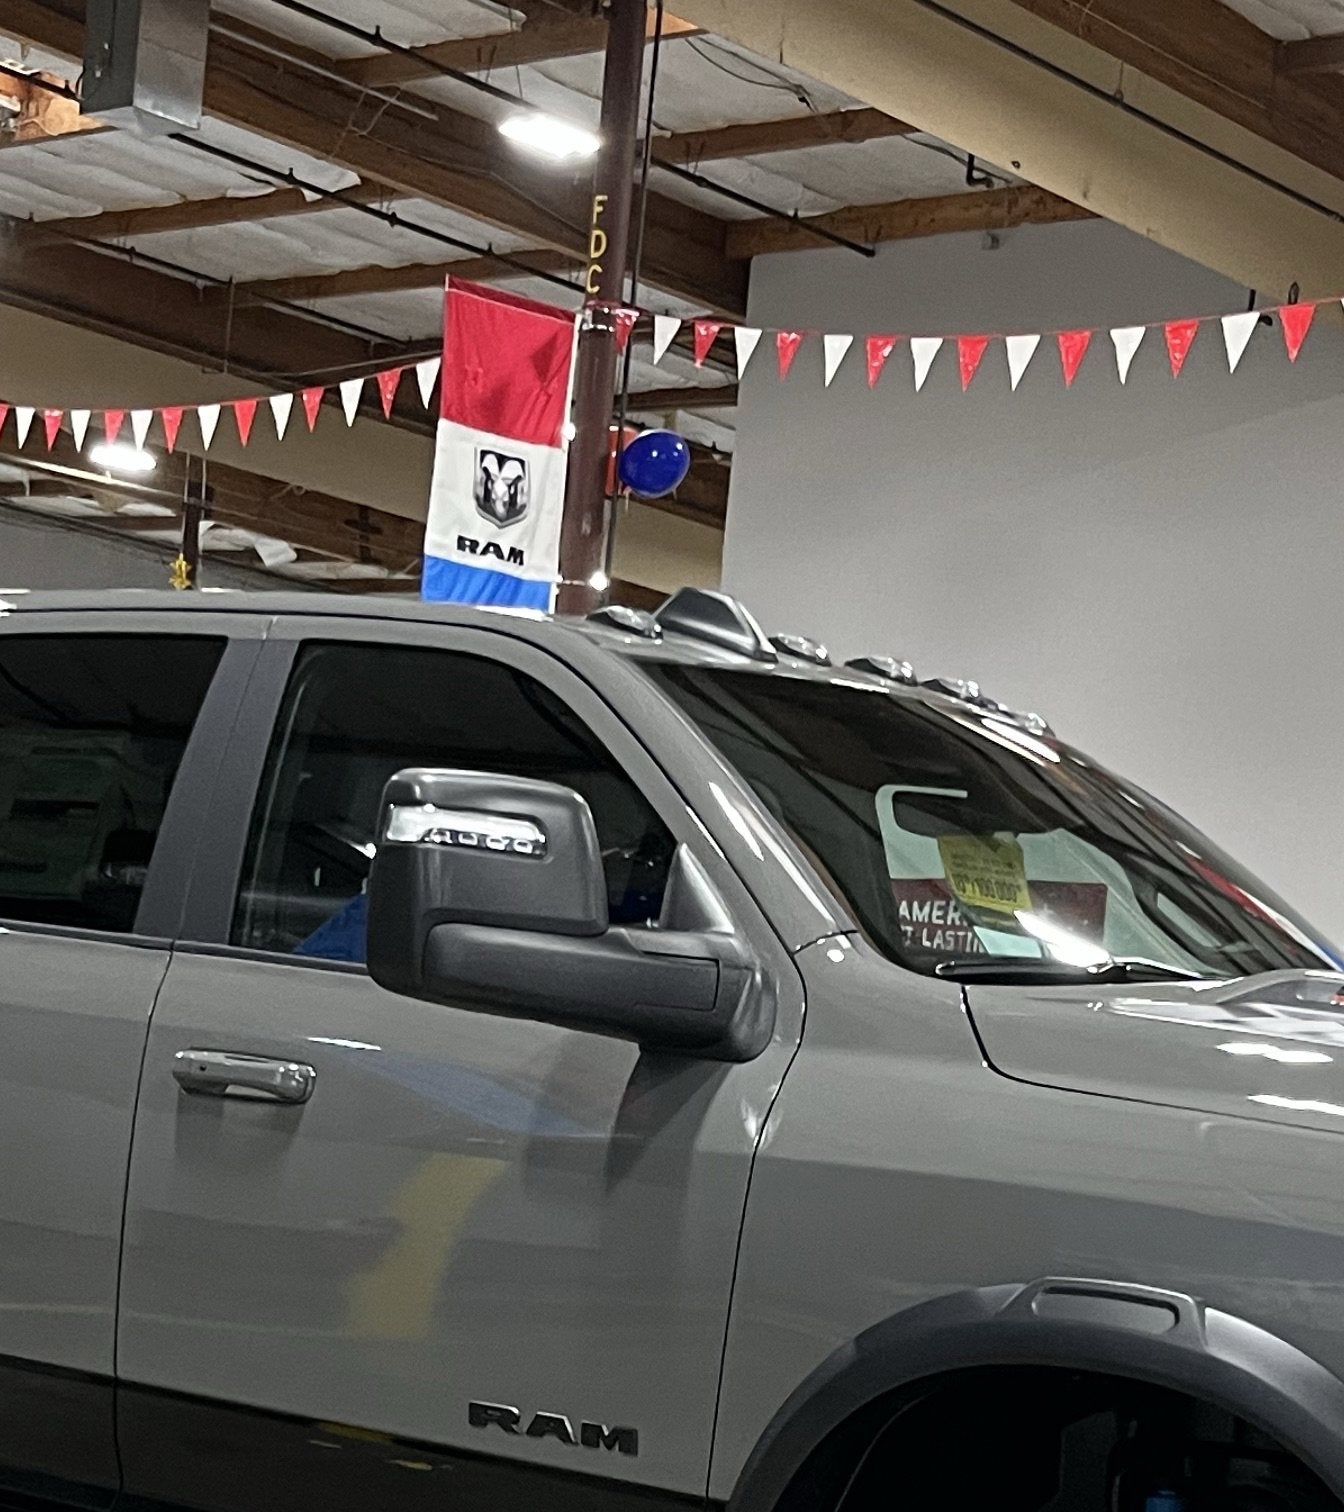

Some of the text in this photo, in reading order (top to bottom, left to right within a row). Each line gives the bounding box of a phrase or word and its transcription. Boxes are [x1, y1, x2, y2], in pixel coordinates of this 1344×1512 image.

[586, 195, 608, 293] FDC
[456, 535, 525, 566] RAM
[899, 900, 968, 926] AMER
[469, 1400, 638, 1457] RAM
